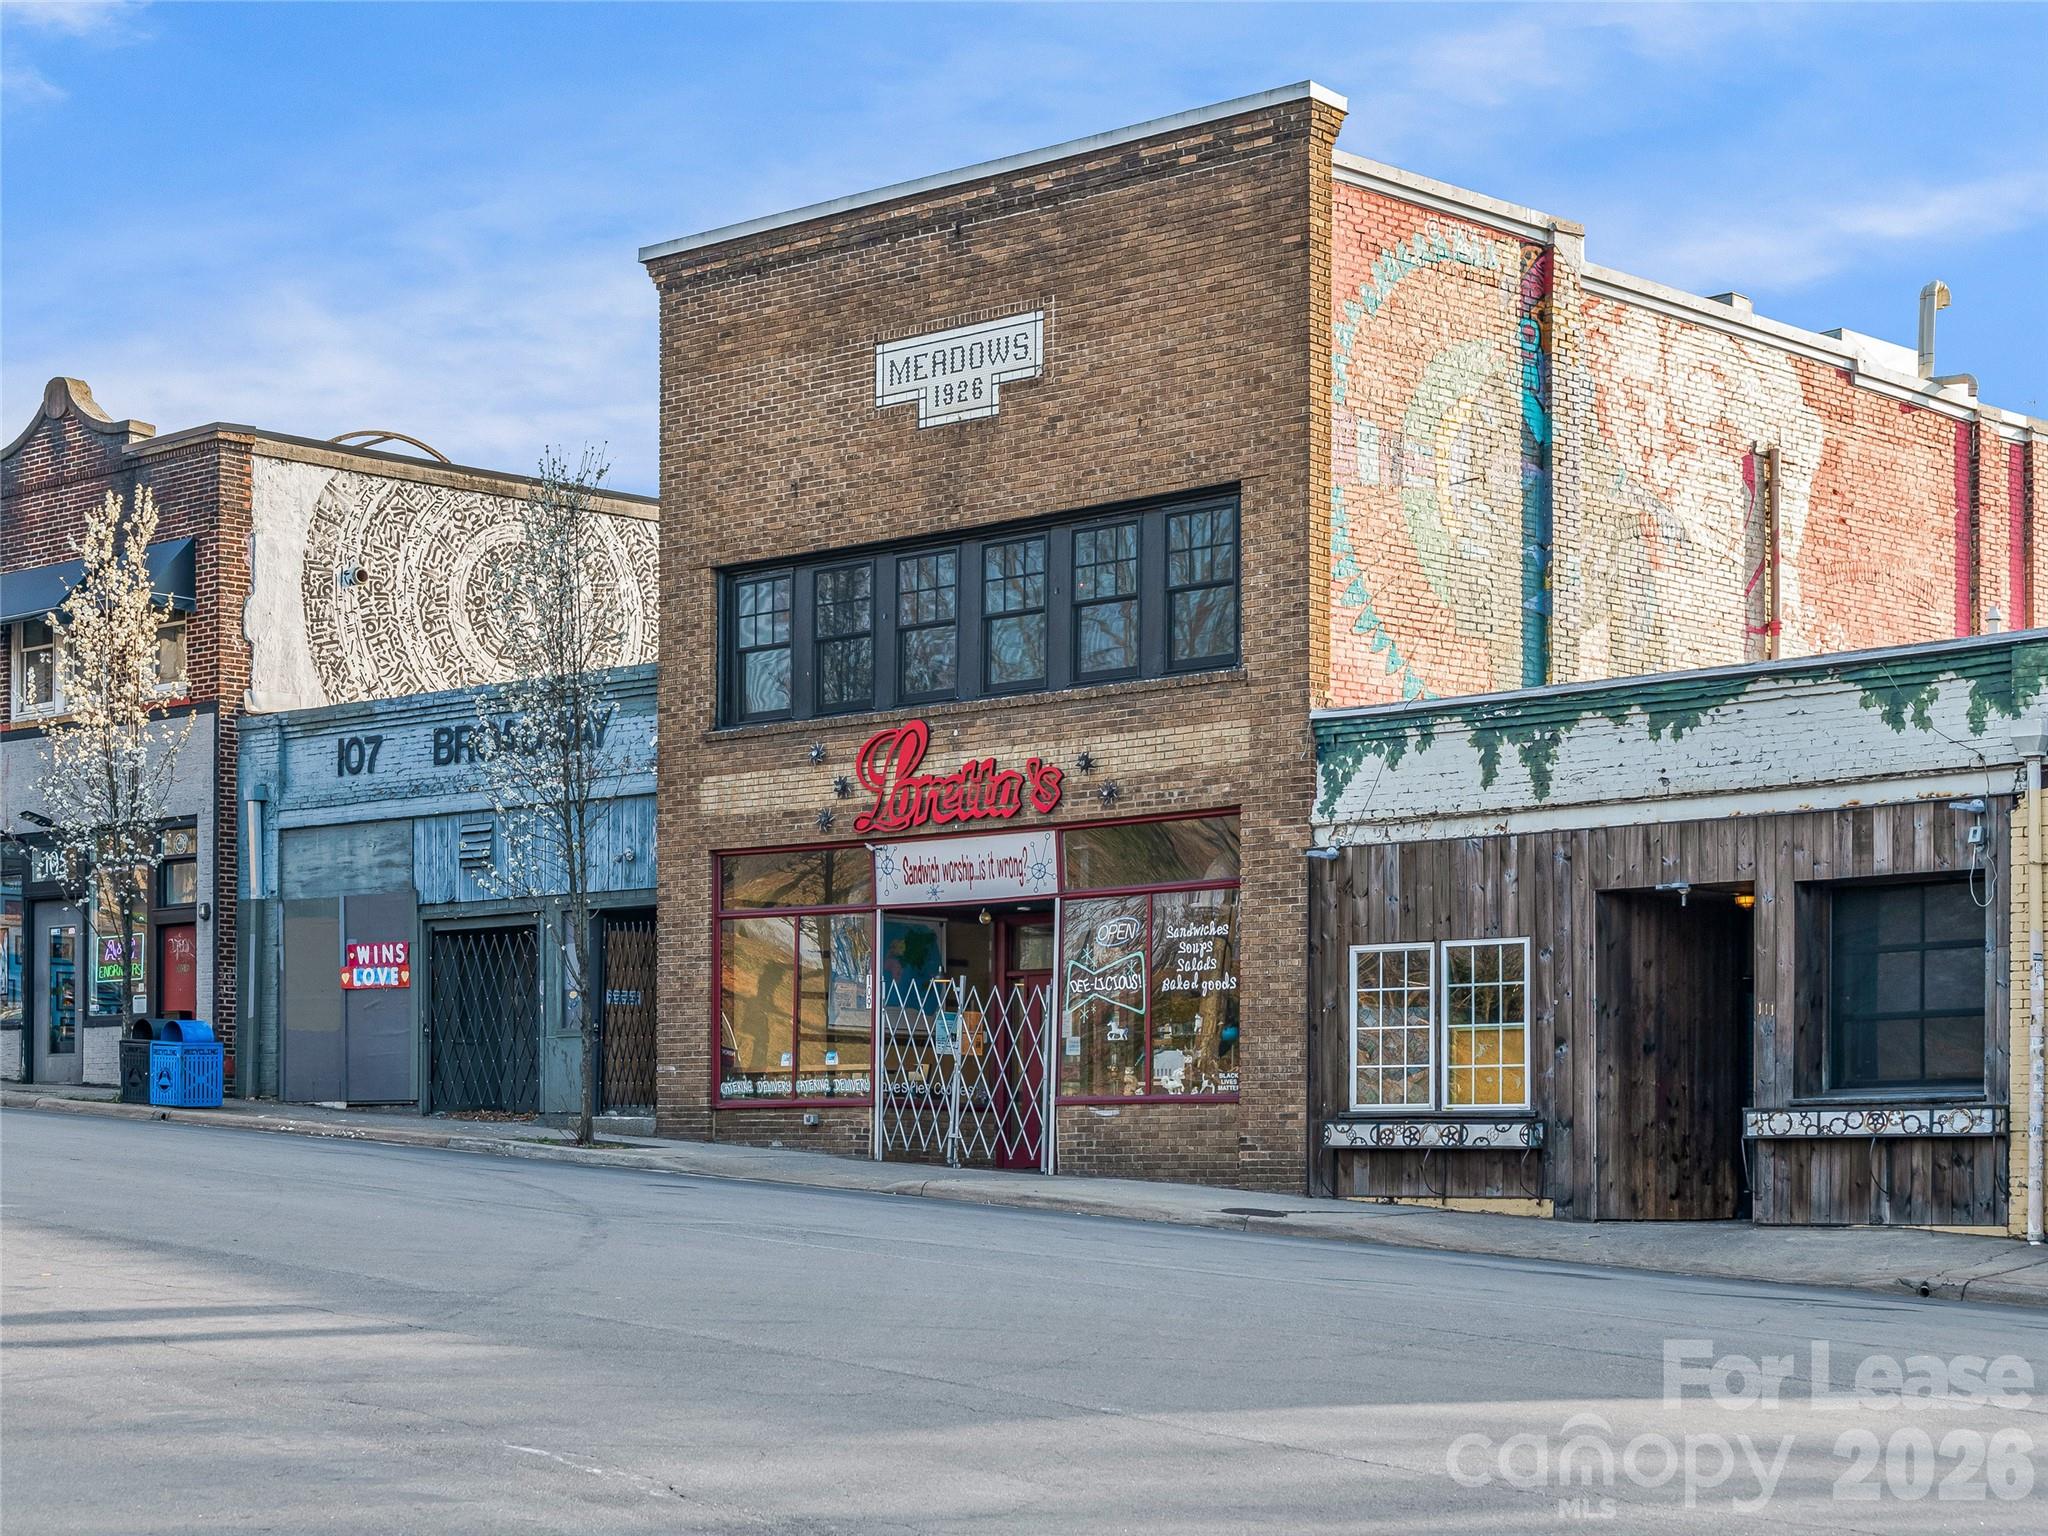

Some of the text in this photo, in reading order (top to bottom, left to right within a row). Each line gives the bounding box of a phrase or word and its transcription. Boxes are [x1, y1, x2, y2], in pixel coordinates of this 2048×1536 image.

[934, 377, 983, 407] 1926
[337, 703, 613, 777] 107 BROAAY
[853, 719, 1064, 834] Loretta's
[902, 855, 940, 885] Sandwich
[987, 851, 995, 880] it
[996, 846, 1028, 887] wrong?
[1097, 922, 1137, 941] OPEN
[1166, 920, 1229, 939] Sandwiches
[356, 943, 405, 965] WINS
[1177, 941, 1213, 957] Soups
[98, 963, 142, 979] ENGRARS
[1176, 956, 1217, 972] Salads
[353, 966, 399, 987] LOVE
[1070, 973, 1143, 994] DEE-LICIOUS!
[1161, 971, 1237, 997] Baked goods
